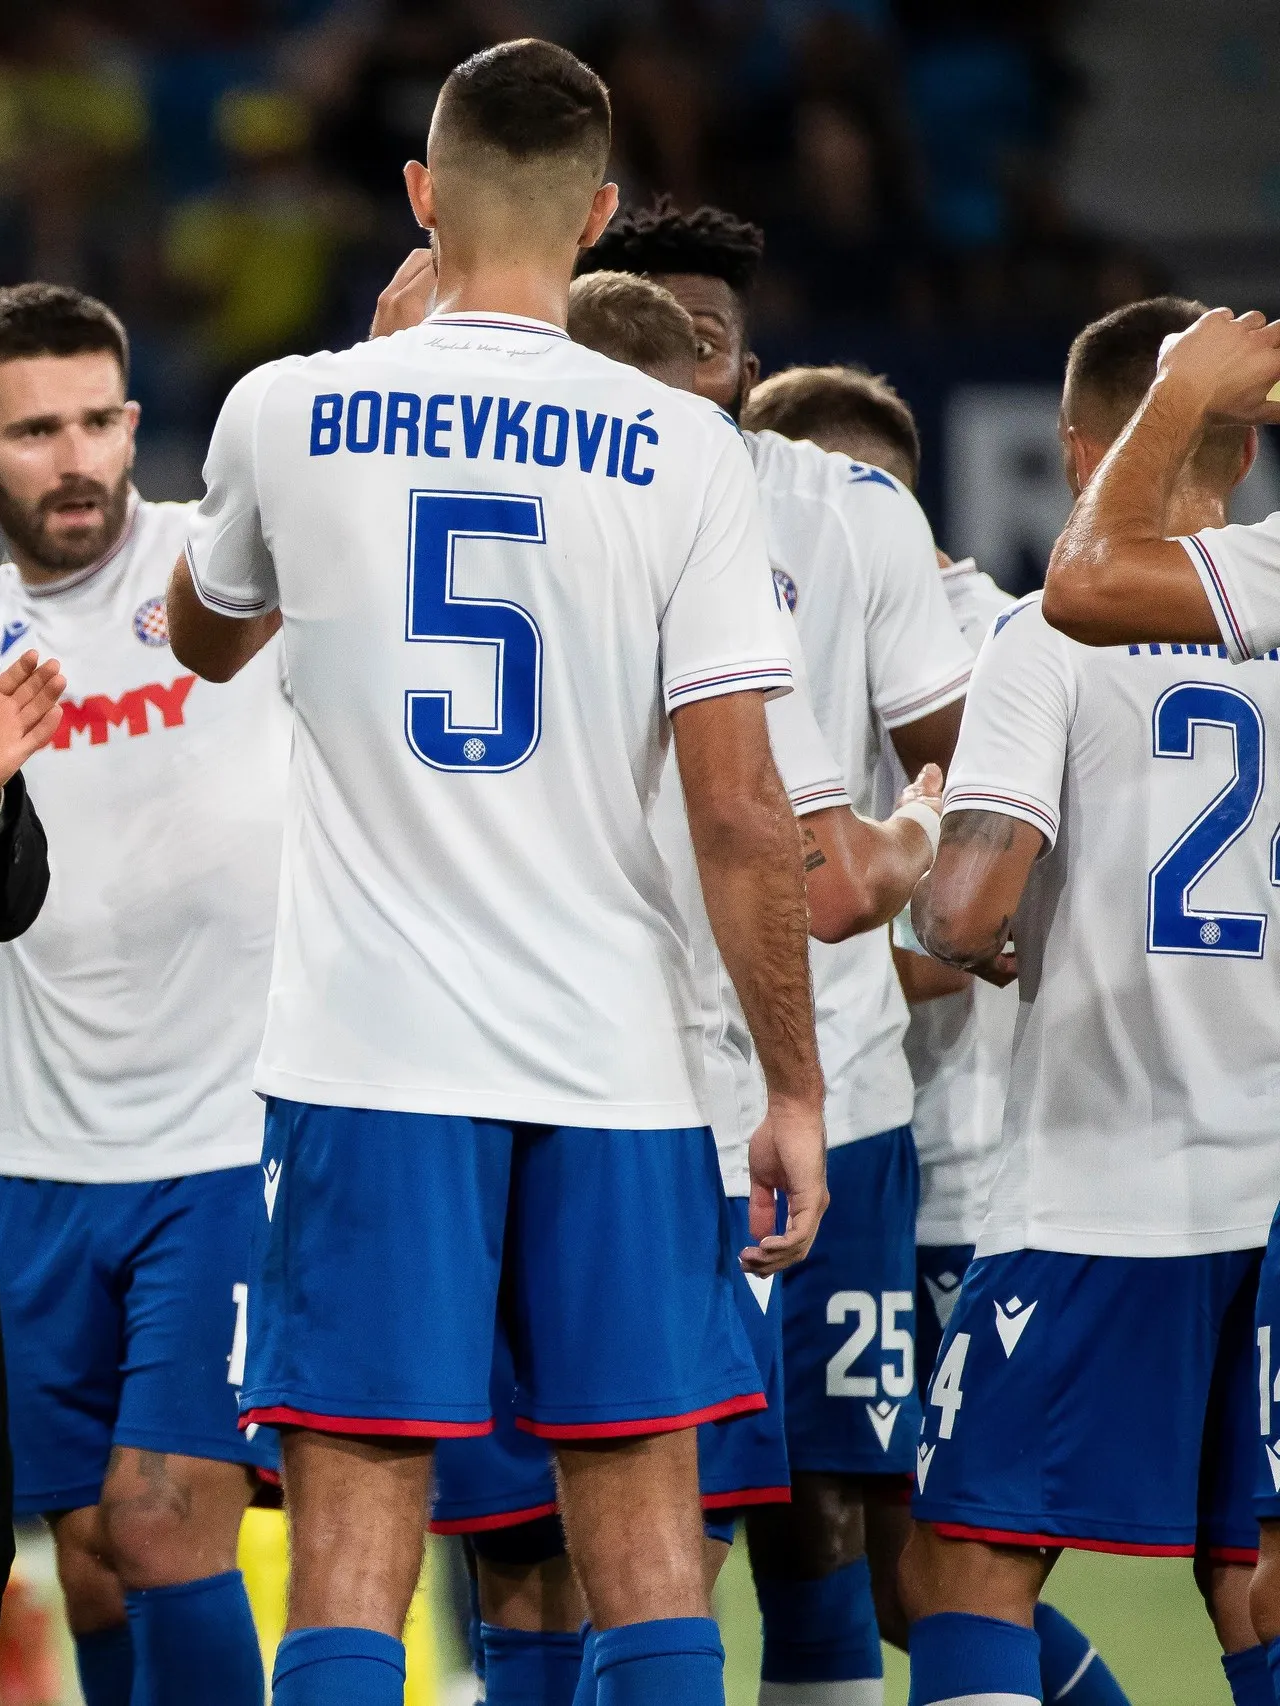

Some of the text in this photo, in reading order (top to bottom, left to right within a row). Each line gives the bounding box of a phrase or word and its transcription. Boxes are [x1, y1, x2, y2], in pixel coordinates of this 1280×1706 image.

[310, 390, 660, 486] BOREVKOVIĆ
[404, 488, 547, 774] 5
[42, 673, 198, 751] MMY
[1146, 680, 1280, 961] 2
[227, 1283, 248, 1388] 1
[826, 1290, 915, 1398] 25
[920, 1332, 971, 1440] 4
[1257, 1325, 1280, 1436] 1
